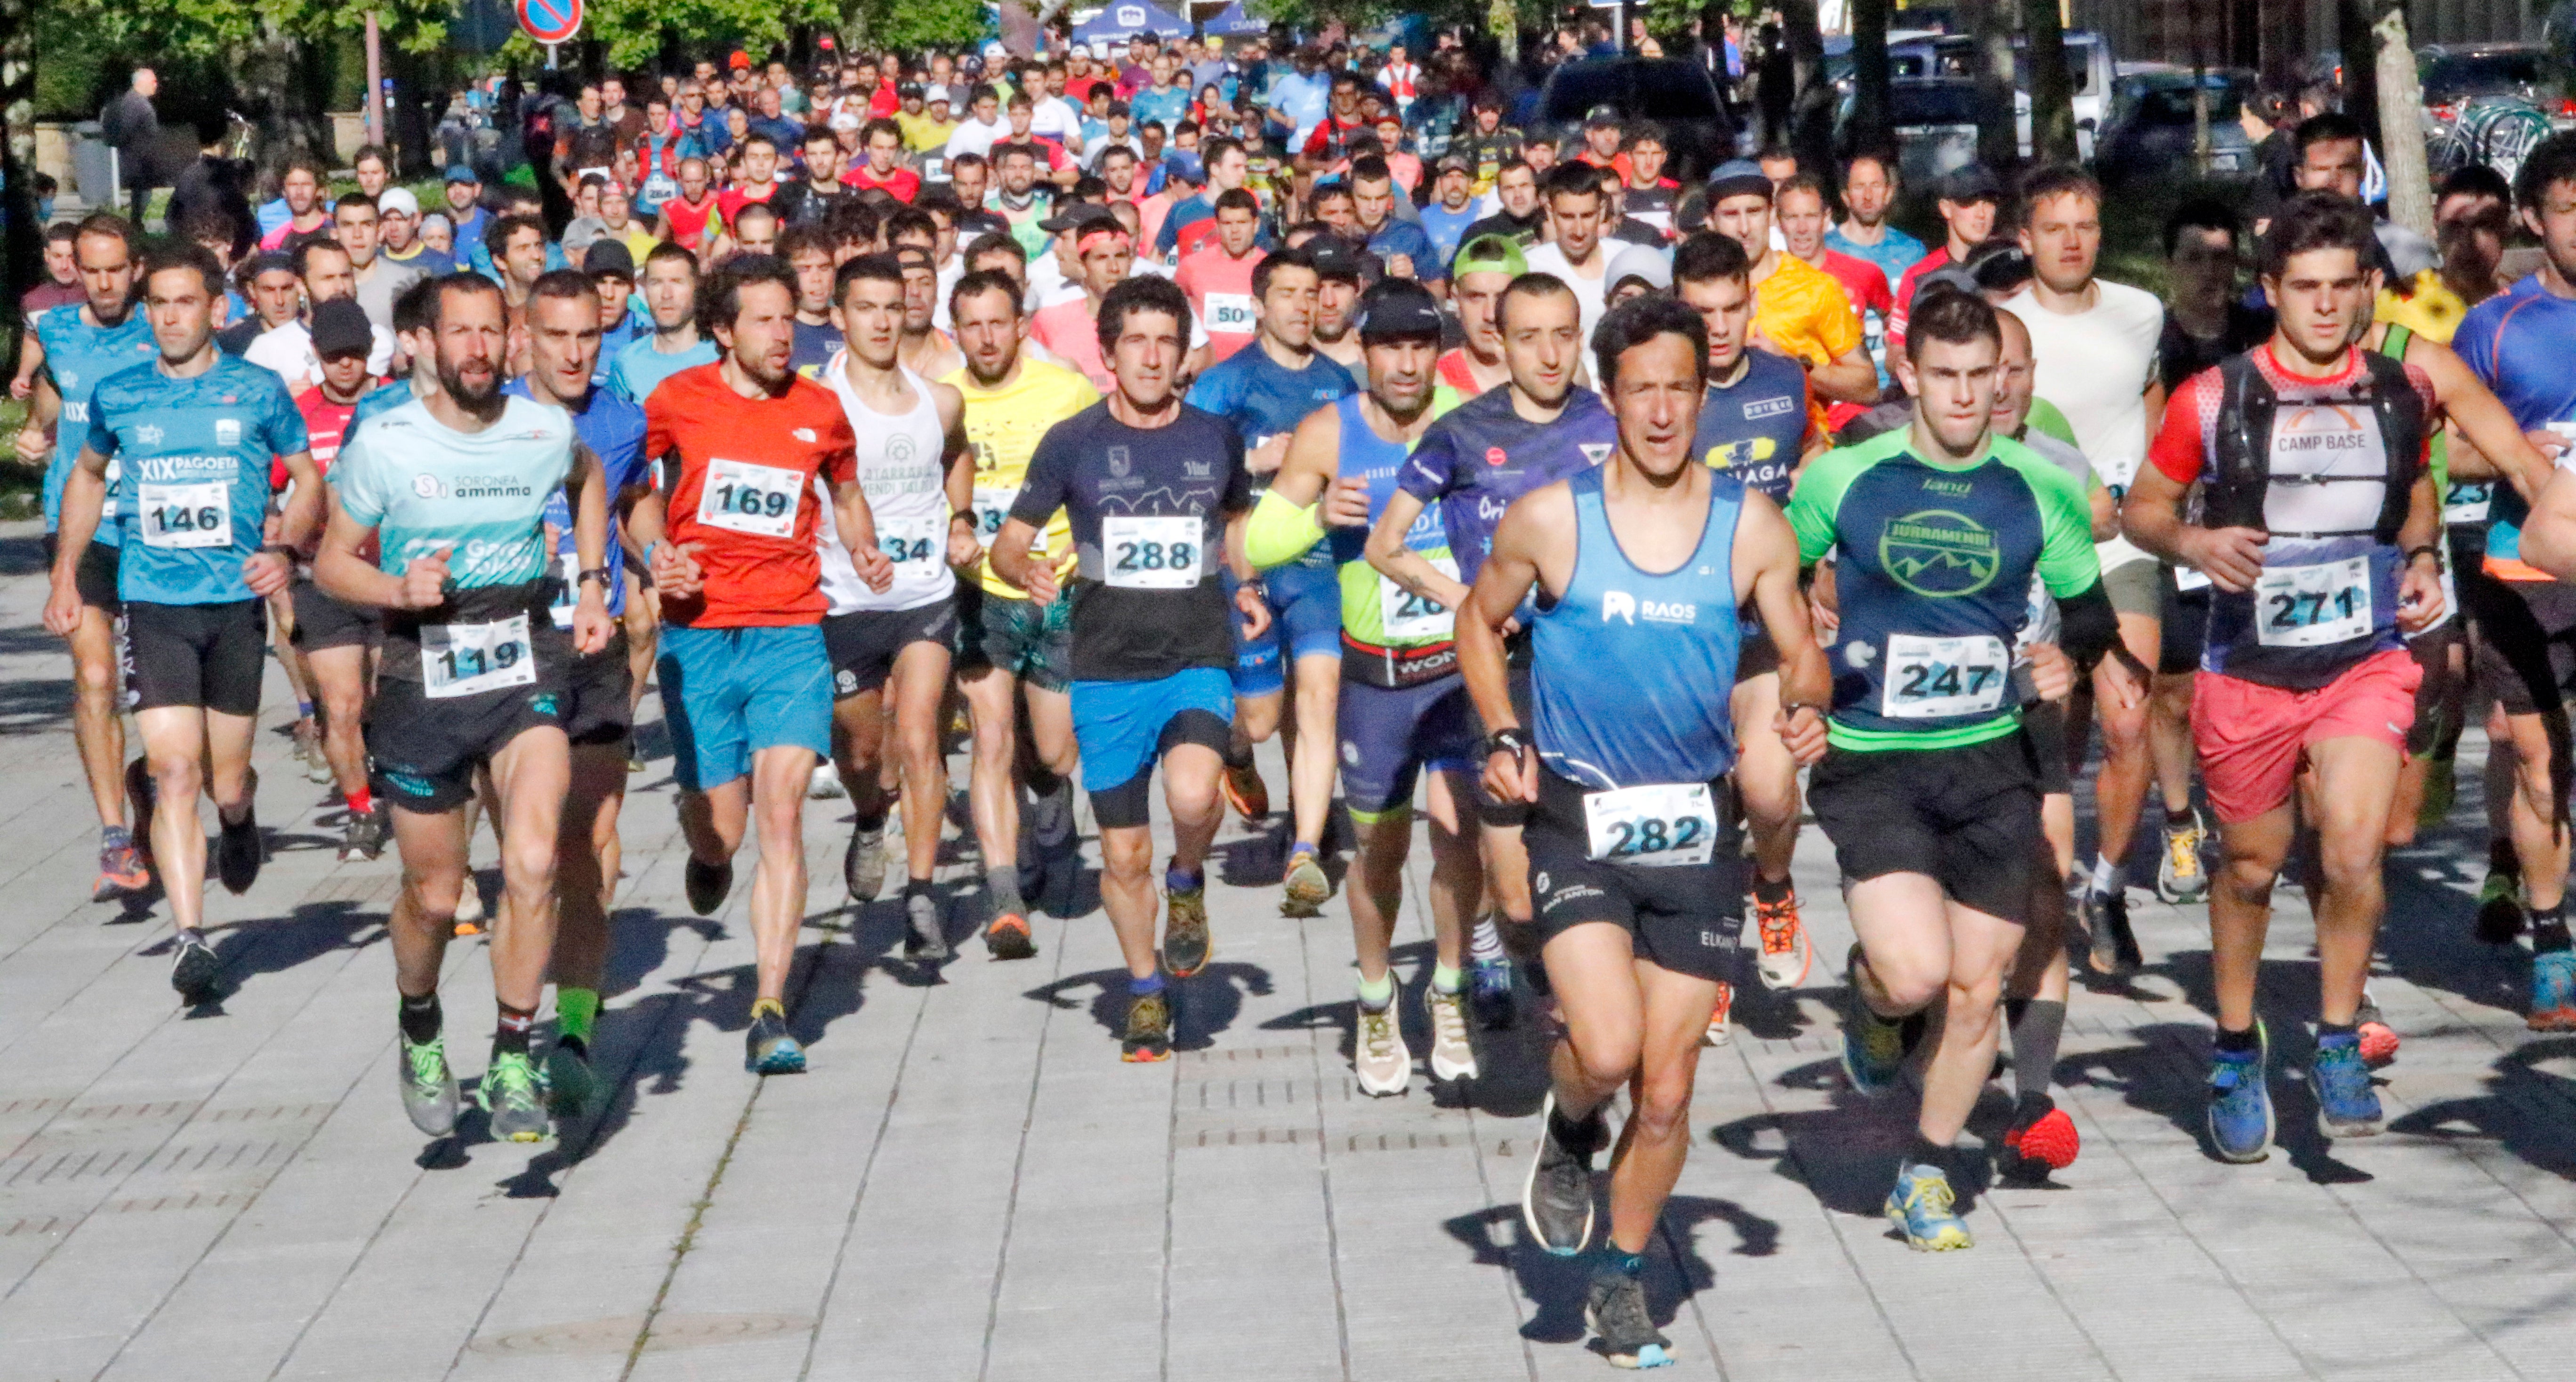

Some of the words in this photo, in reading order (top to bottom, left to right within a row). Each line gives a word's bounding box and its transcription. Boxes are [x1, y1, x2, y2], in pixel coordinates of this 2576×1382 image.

[1218, 306, 1244, 322] 50
[2278, 436, 2322, 452] CAMP
[2326, 434, 2366, 450] BASE
[137, 457, 177, 482] XIX
[175, 456, 240, 470] PAGOETA
[455, 486, 531, 498] ammma
[716, 482, 788, 519] 169
[152, 506, 219, 532] 146
[1116, 542, 1191, 570] 288
[1642, 600, 1696, 619] RAOS
[2270, 586, 2353, 627] 271
[437, 641, 518, 679] 119
[1899, 664, 1996, 697] 247
[1606, 816, 1702, 858] 282
